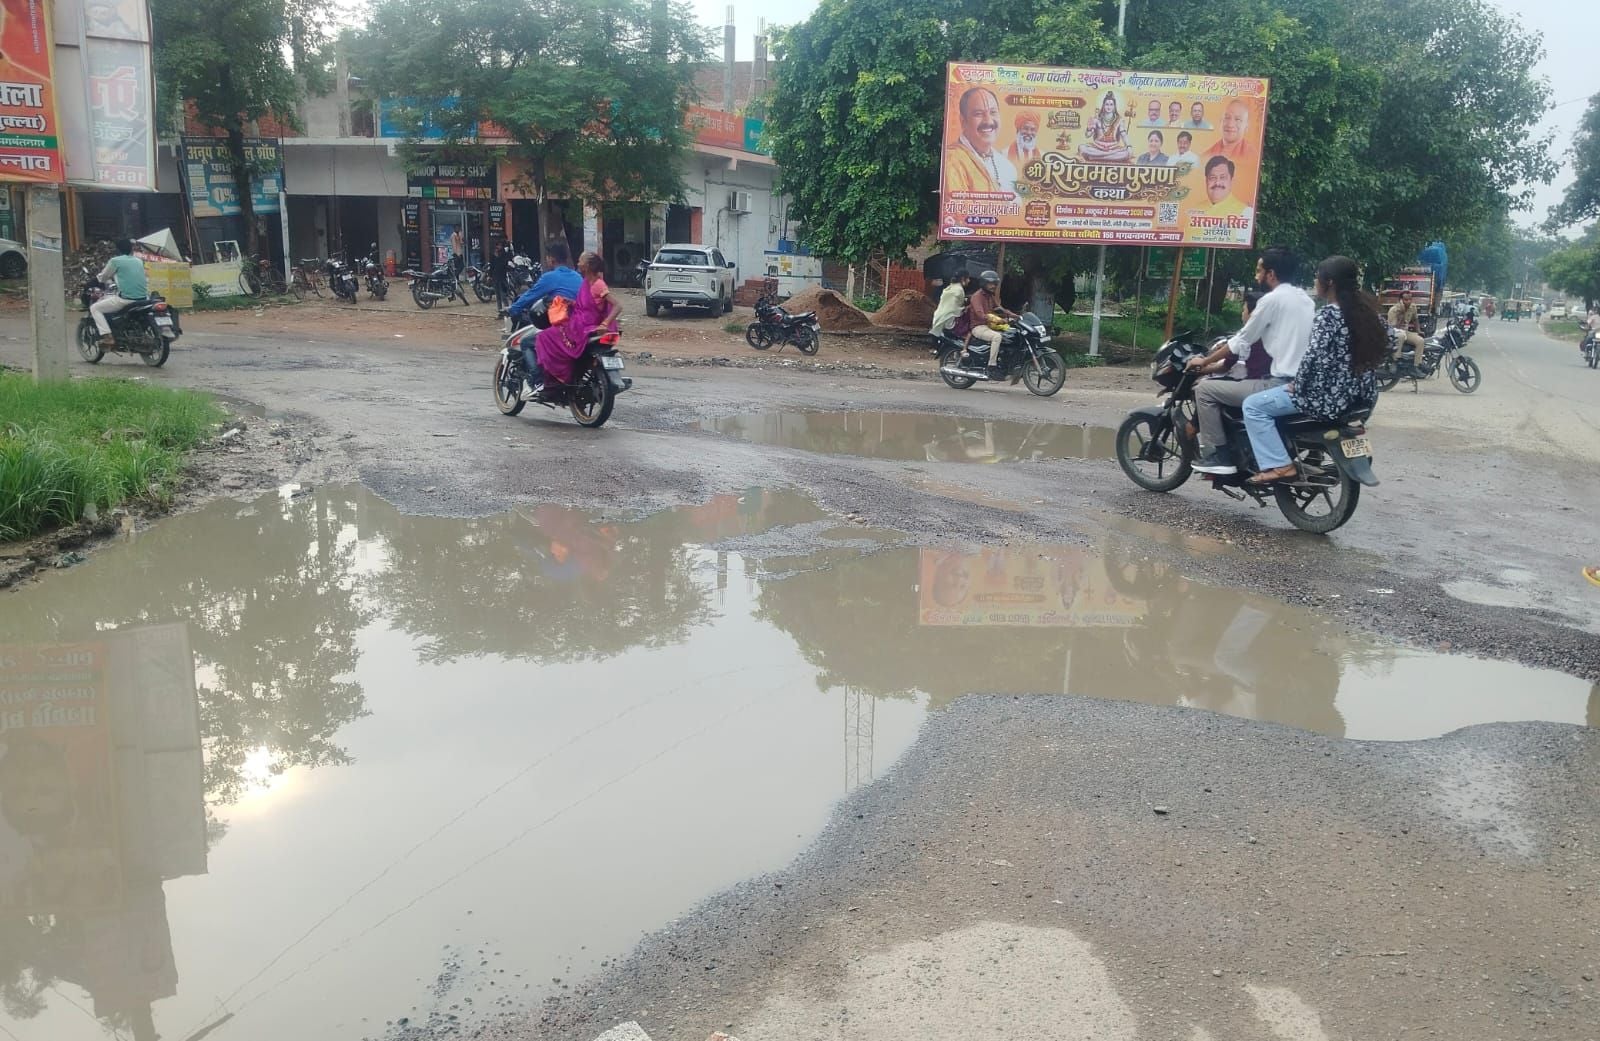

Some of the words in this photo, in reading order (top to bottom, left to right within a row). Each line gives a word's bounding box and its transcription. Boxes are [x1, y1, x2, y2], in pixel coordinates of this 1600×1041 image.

[1026, 71, 1045, 82] नाग
[1047, 70, 1072, 84] पंचमी
[0, 81, 43, 107] क्ला
[0, 154, 51, 170] न्नाव
[438, 165, 465, 177] MOBE
[1027, 162, 1043, 178] श्री
[1043, 152, 1178, 192] शिवमहापुराण
[1094, 188, 1126, 200] कथा
[1227, 214, 1250, 230] सिंह
